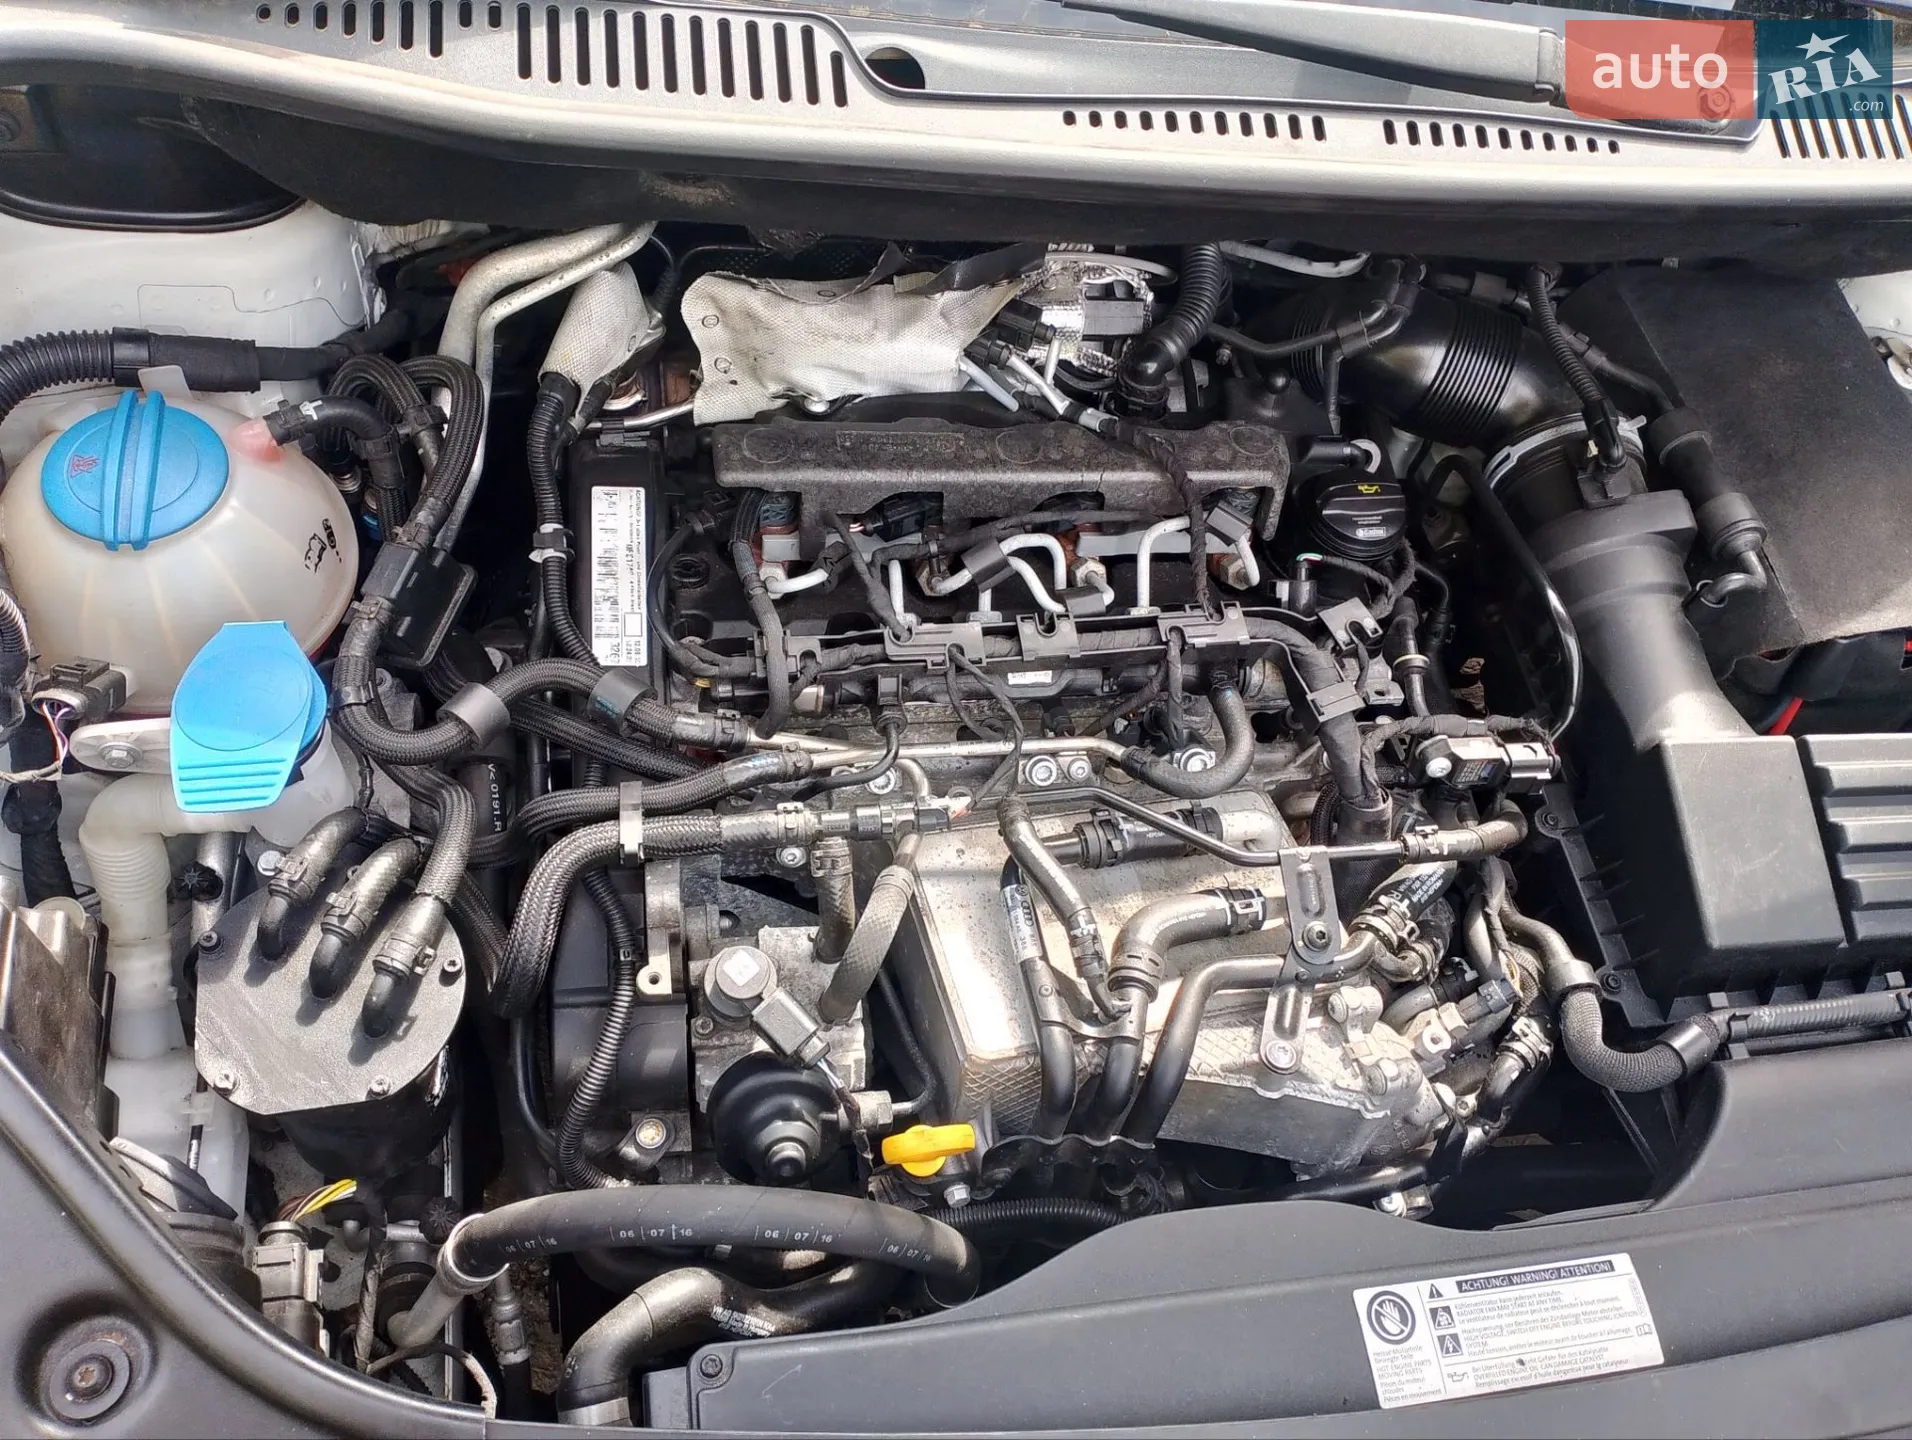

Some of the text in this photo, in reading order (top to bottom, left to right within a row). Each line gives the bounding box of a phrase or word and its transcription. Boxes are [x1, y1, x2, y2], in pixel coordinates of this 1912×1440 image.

[619, 1228, 693, 1239] 06 07 16
[764, 1229, 779, 1239] 06
[794, 1231, 810, 1241] 07
[1460, 1262, 1612, 1291] ACHTUNG! WARNING! ATTENTION!
